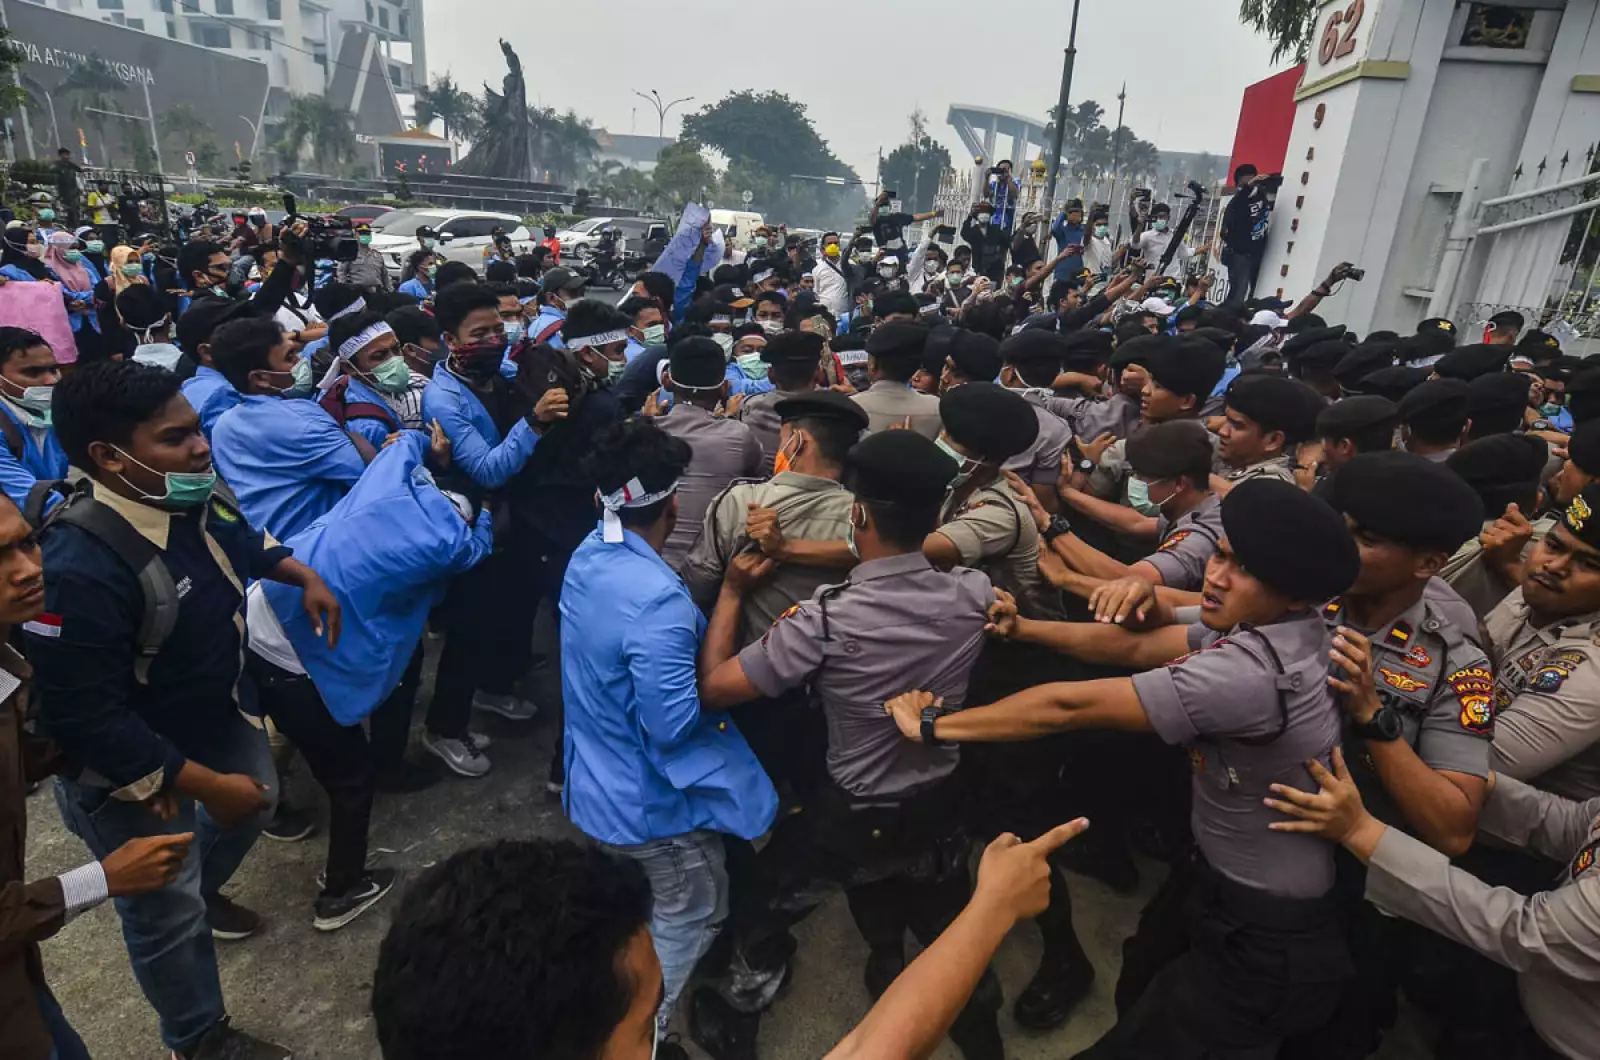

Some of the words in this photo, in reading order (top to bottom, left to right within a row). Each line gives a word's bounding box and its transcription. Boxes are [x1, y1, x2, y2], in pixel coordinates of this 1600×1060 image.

[1319, 0, 1364, 66] 62
[1314, 103, 1326, 130] 9
[1448, 668, 1492, 683] POLDA
[1457, 681, 1491, 693] RIAU
